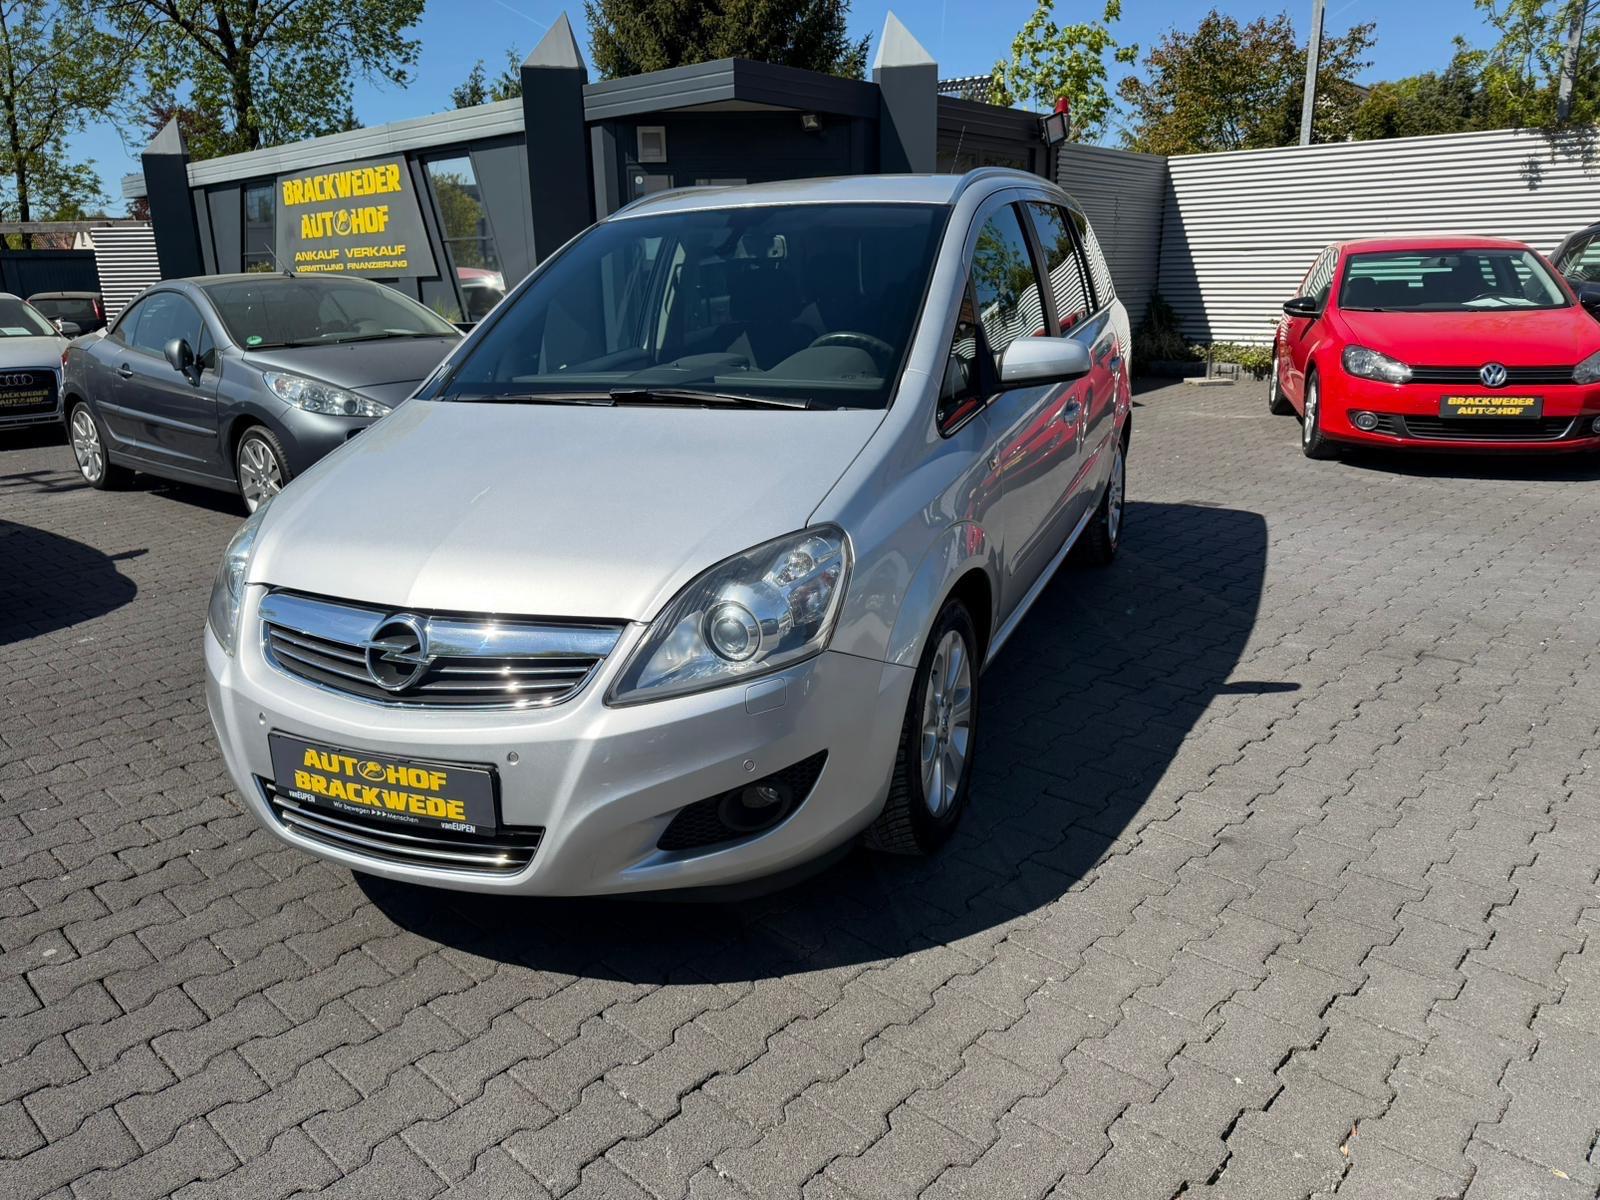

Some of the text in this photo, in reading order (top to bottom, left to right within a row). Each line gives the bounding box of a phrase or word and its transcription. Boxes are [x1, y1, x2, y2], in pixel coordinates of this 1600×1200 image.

[282, 163, 402, 206] BRACKWEDER
[294, 244, 406, 262] ANKAUF VERKAUF
[296, 260, 408, 273] VERMITTLUNG FINANZIERUNG
[1447, 397, 1535, 406] BRACKWEDER
[294, 769, 467, 821] BRACKWEDE
[333, 800, 419, 824] Wir bewegen Menschen
